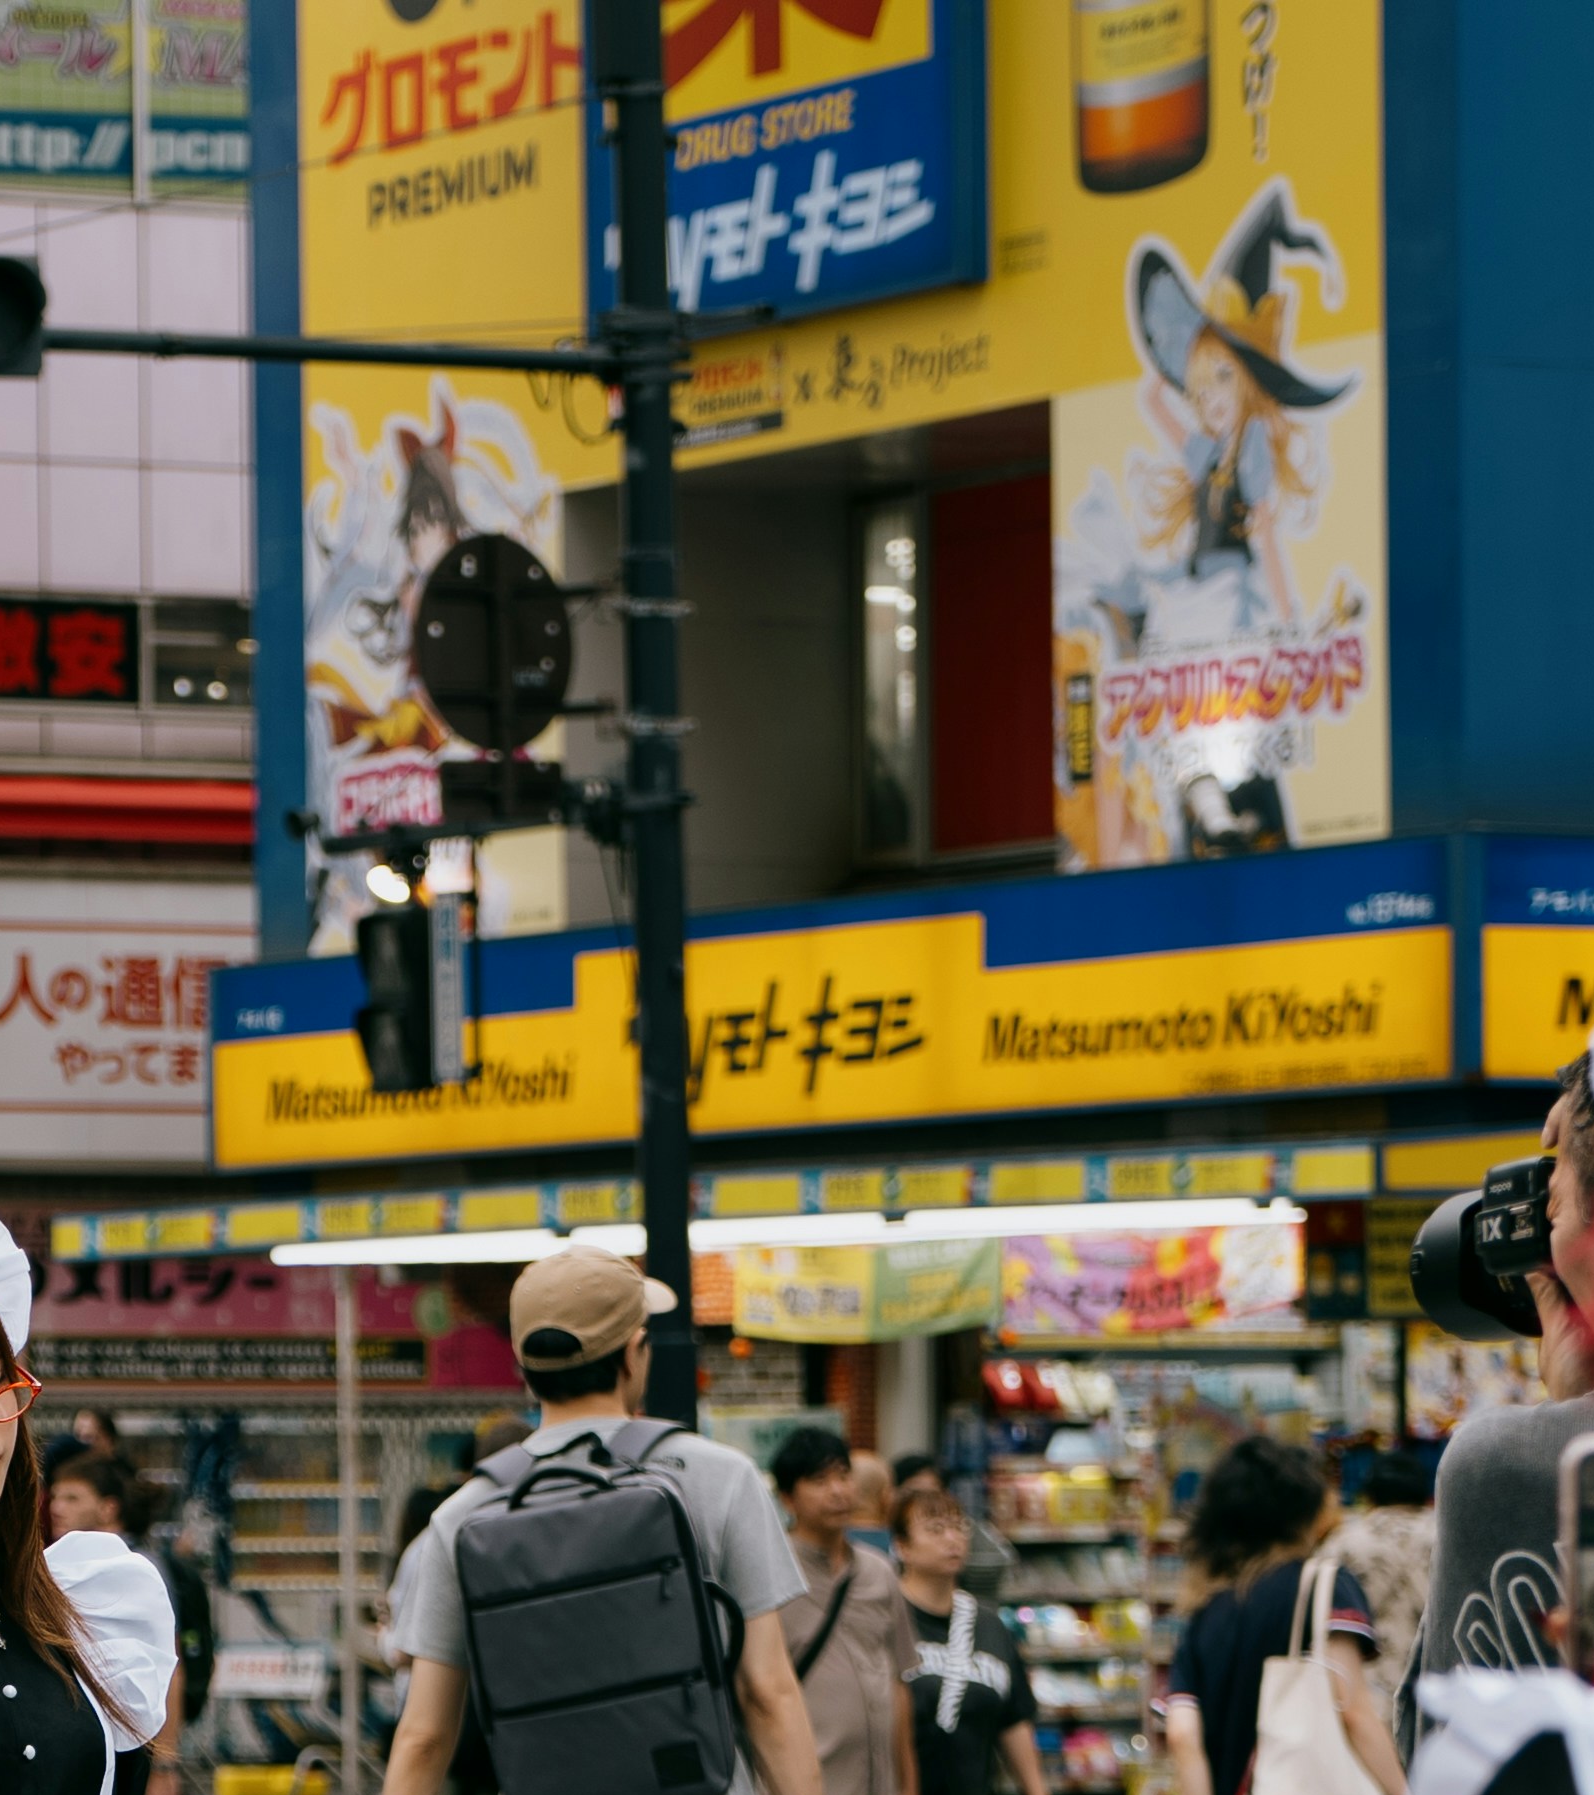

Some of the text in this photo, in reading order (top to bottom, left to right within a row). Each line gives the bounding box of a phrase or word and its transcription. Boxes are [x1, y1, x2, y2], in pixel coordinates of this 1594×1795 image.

[673, 89, 856, 172] DRUG STORE
[368, 142, 538, 228] PREMIUM
[605, 149, 936, 313] ツモトキヨシ
[982, 978, 1383, 1064] Matsumoto KiYoshi
[32, 1258, 276, 1307] メルシー
